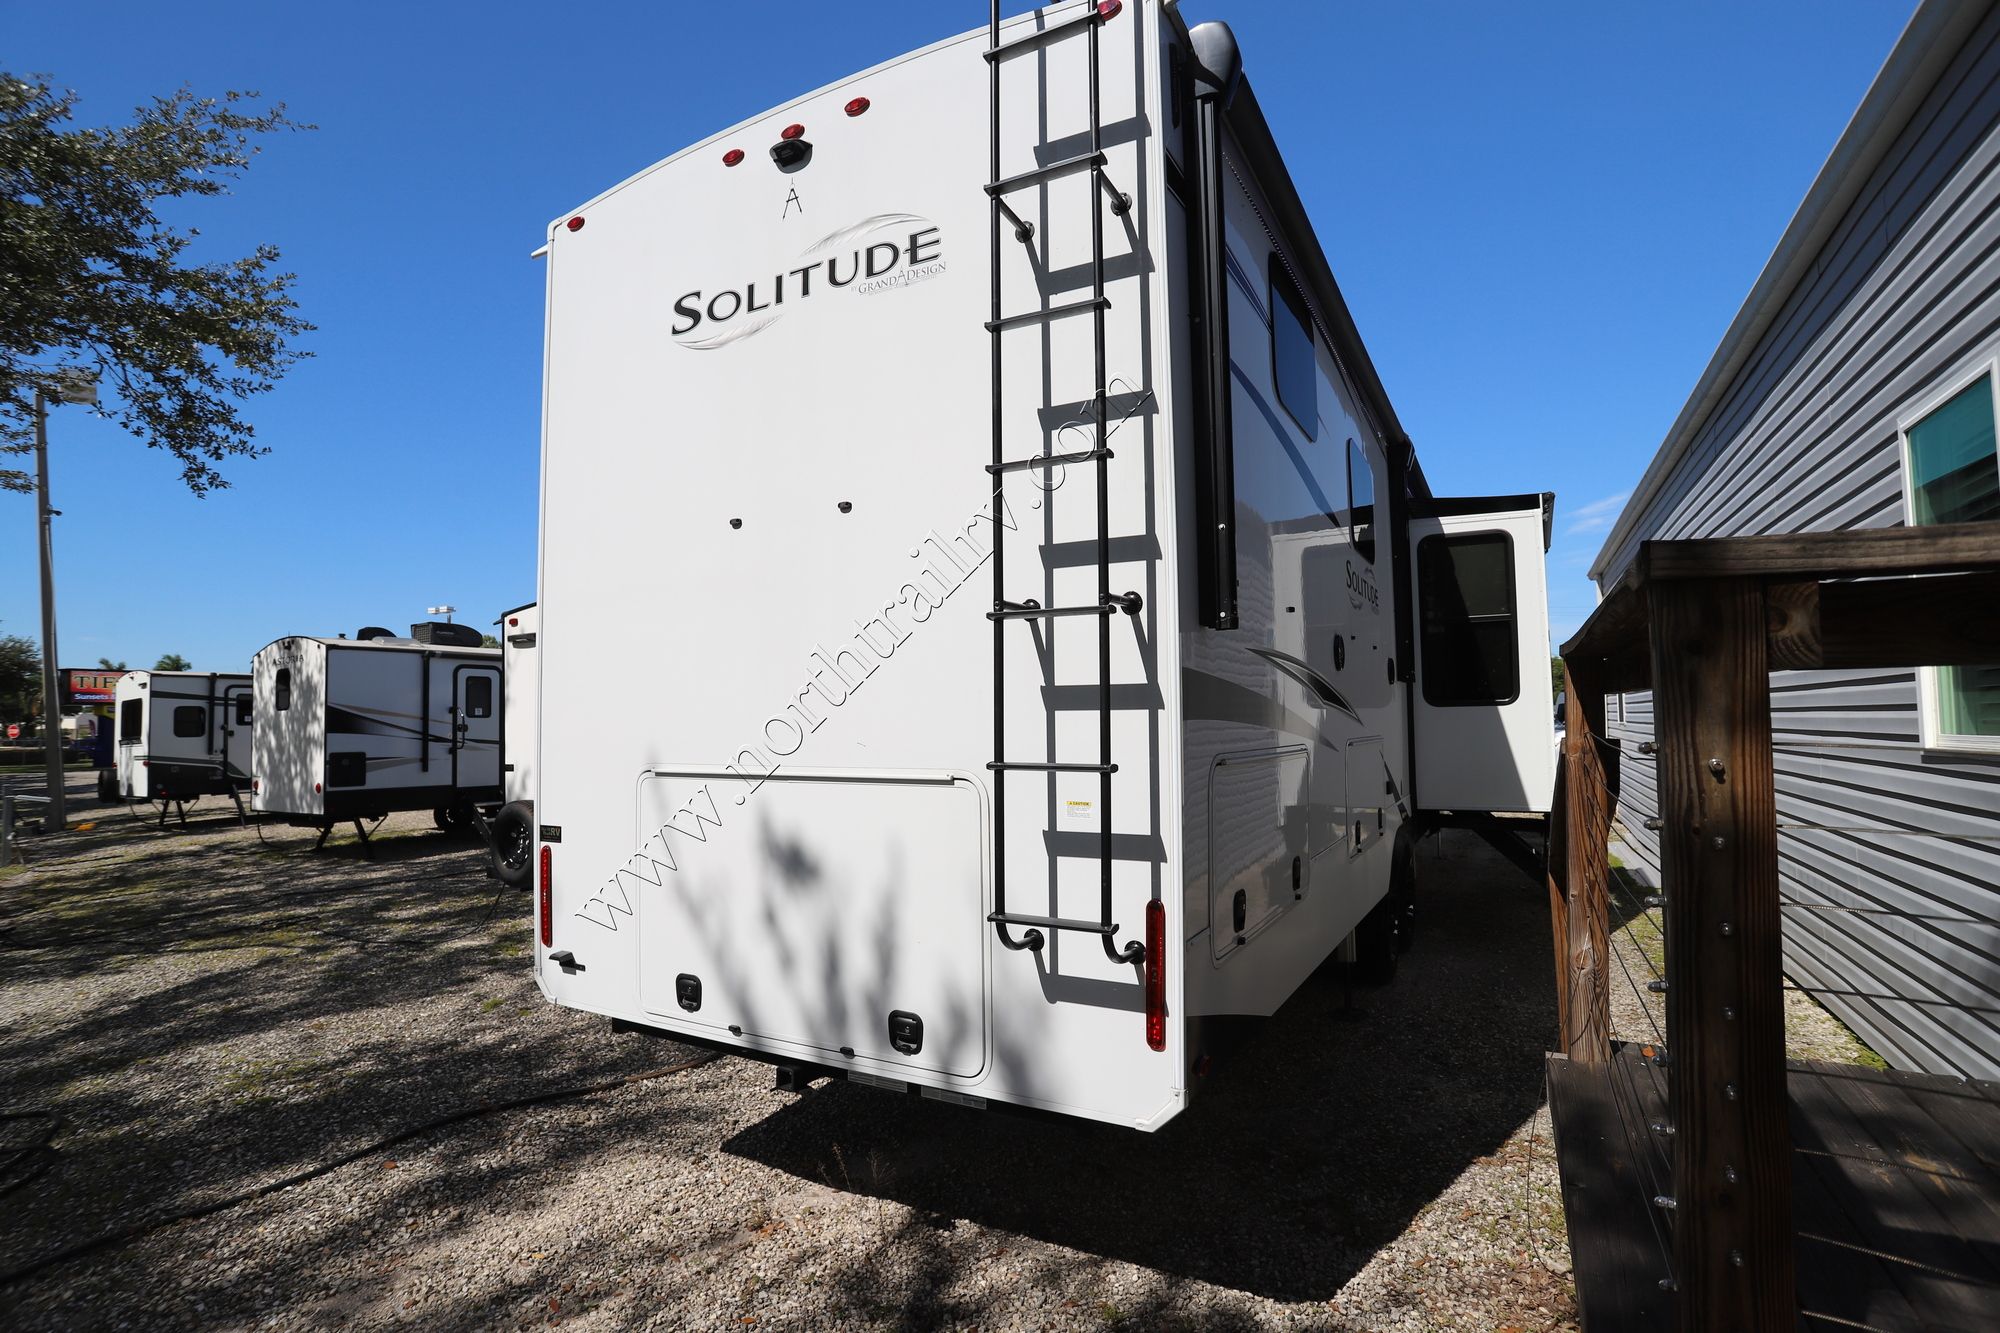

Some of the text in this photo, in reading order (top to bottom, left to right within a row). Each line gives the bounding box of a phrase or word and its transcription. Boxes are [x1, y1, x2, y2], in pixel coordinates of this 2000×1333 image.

[671, 226, 942, 336] SOLITUDE
[858, 276, 897, 293] GRAND
[907, 262, 946, 280] DESIGN
[74, 676, 117, 688] TIF
[551, 827, 560, 836] RV
